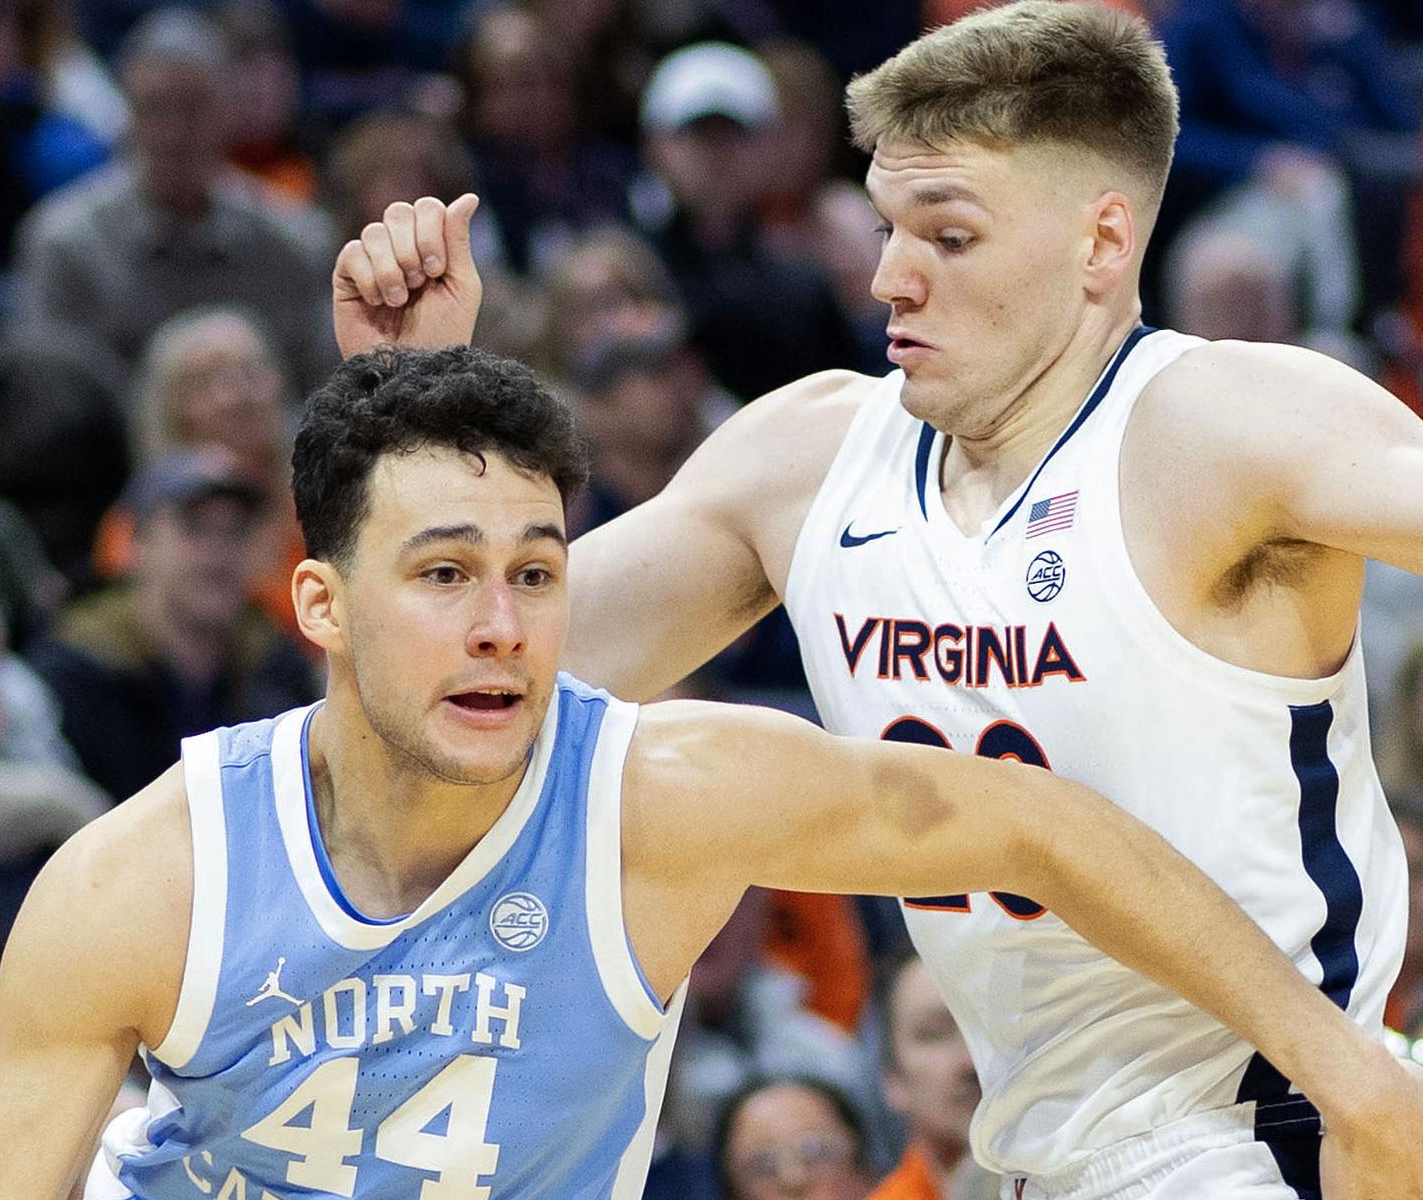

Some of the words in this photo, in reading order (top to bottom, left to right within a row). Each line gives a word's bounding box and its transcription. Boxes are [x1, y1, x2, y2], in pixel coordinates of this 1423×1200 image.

[834, 612, 1087, 688] VIRGINIA
[498, 911, 543, 925] ACC
[268, 972, 527, 1066] NORTH
